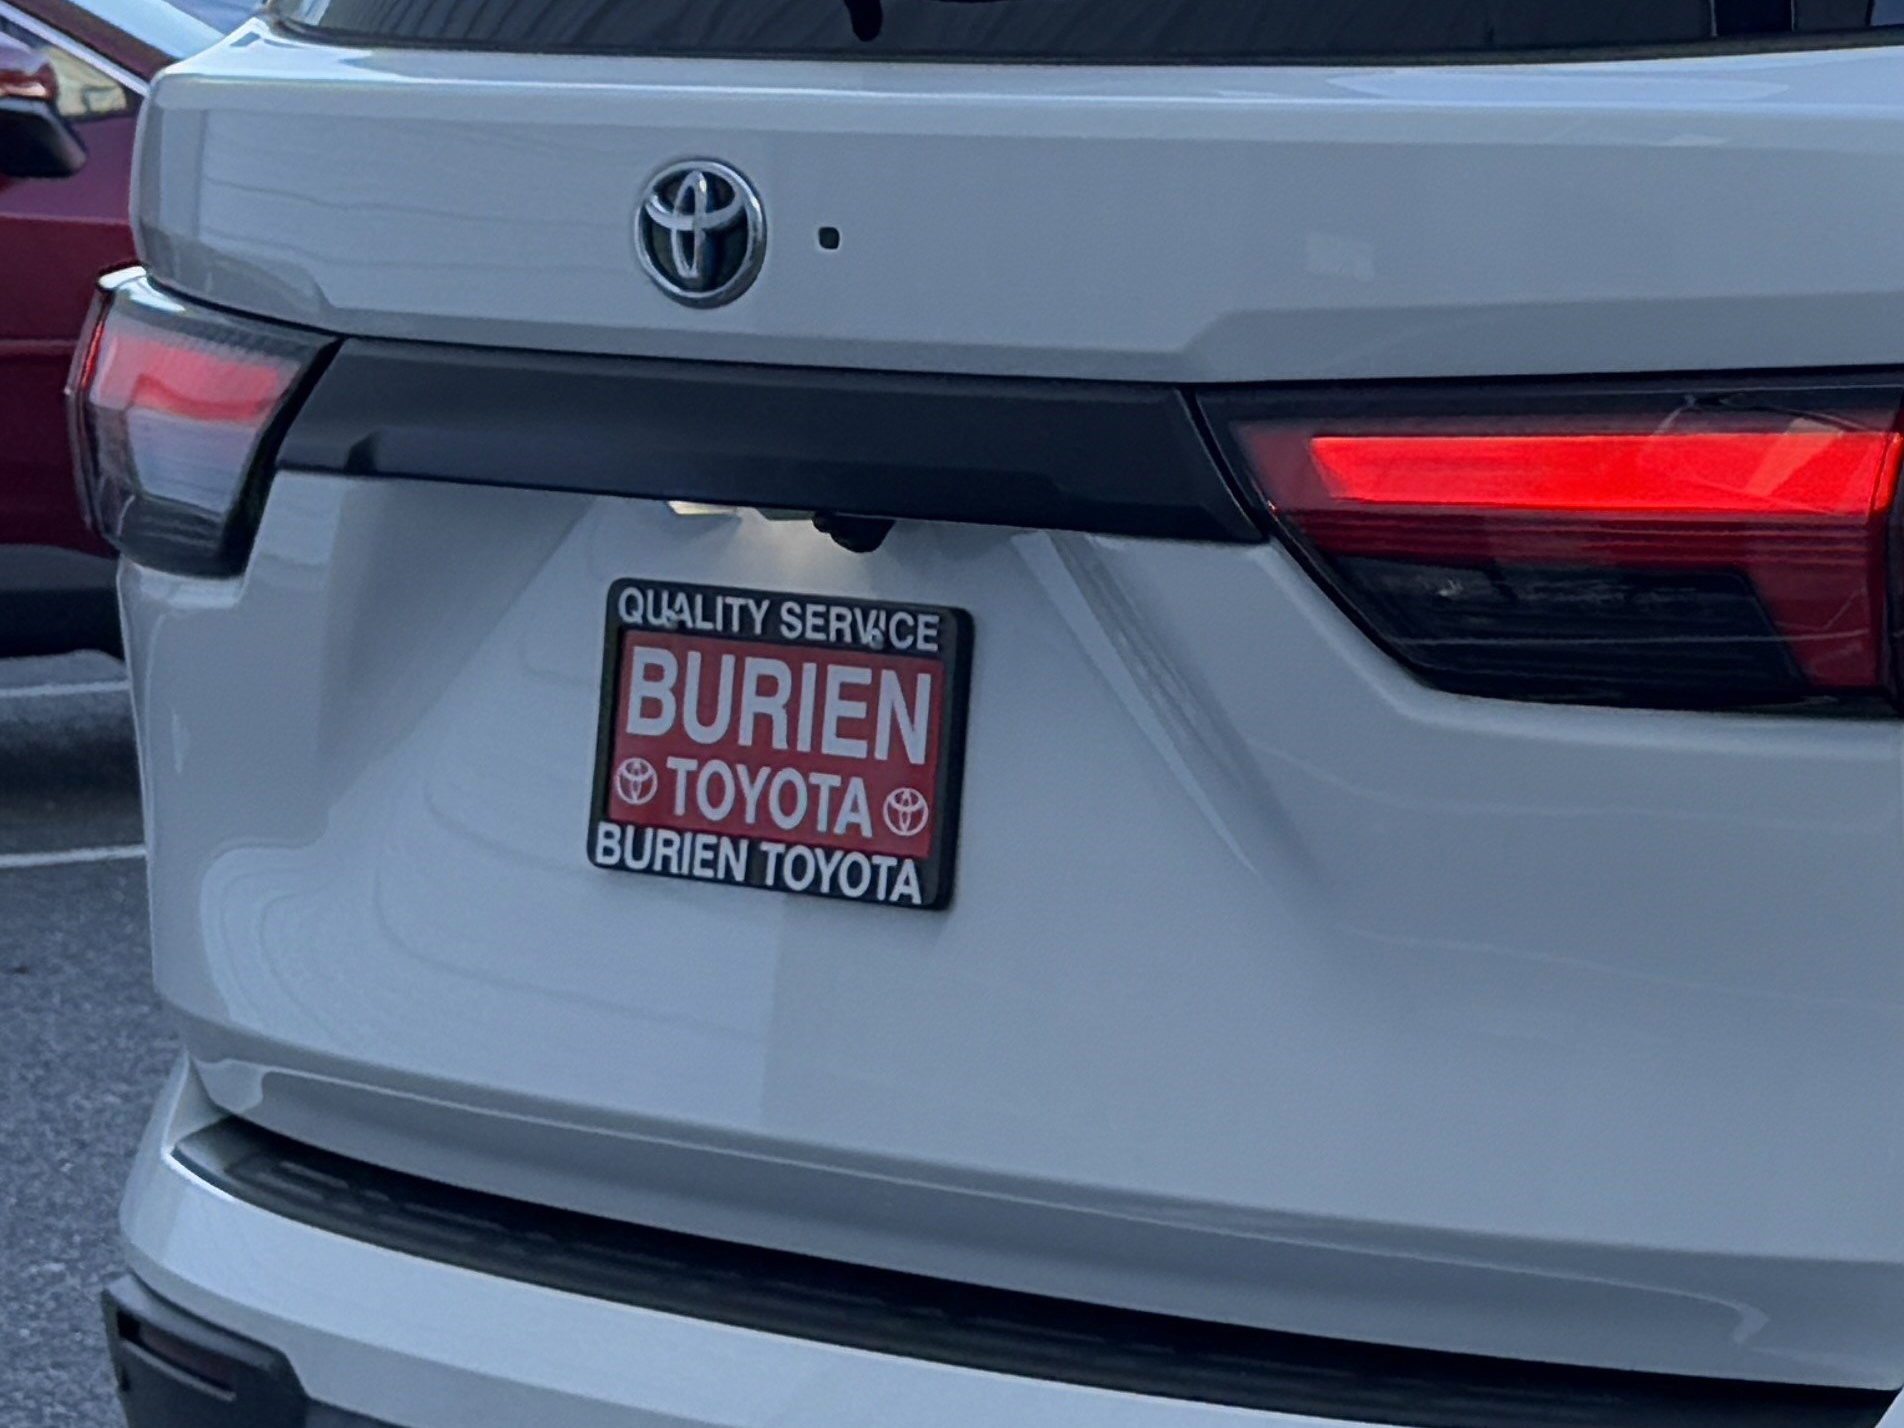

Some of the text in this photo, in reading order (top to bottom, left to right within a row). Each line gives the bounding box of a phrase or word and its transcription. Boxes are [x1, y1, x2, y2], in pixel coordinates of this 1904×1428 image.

[618, 588, 940, 652] QUALITY SERVICE
[626, 646, 931, 765] BURIEN
[667, 756, 873, 839] TOYOTA
[596, 822, 922, 905] BURIEN TOYOTA
